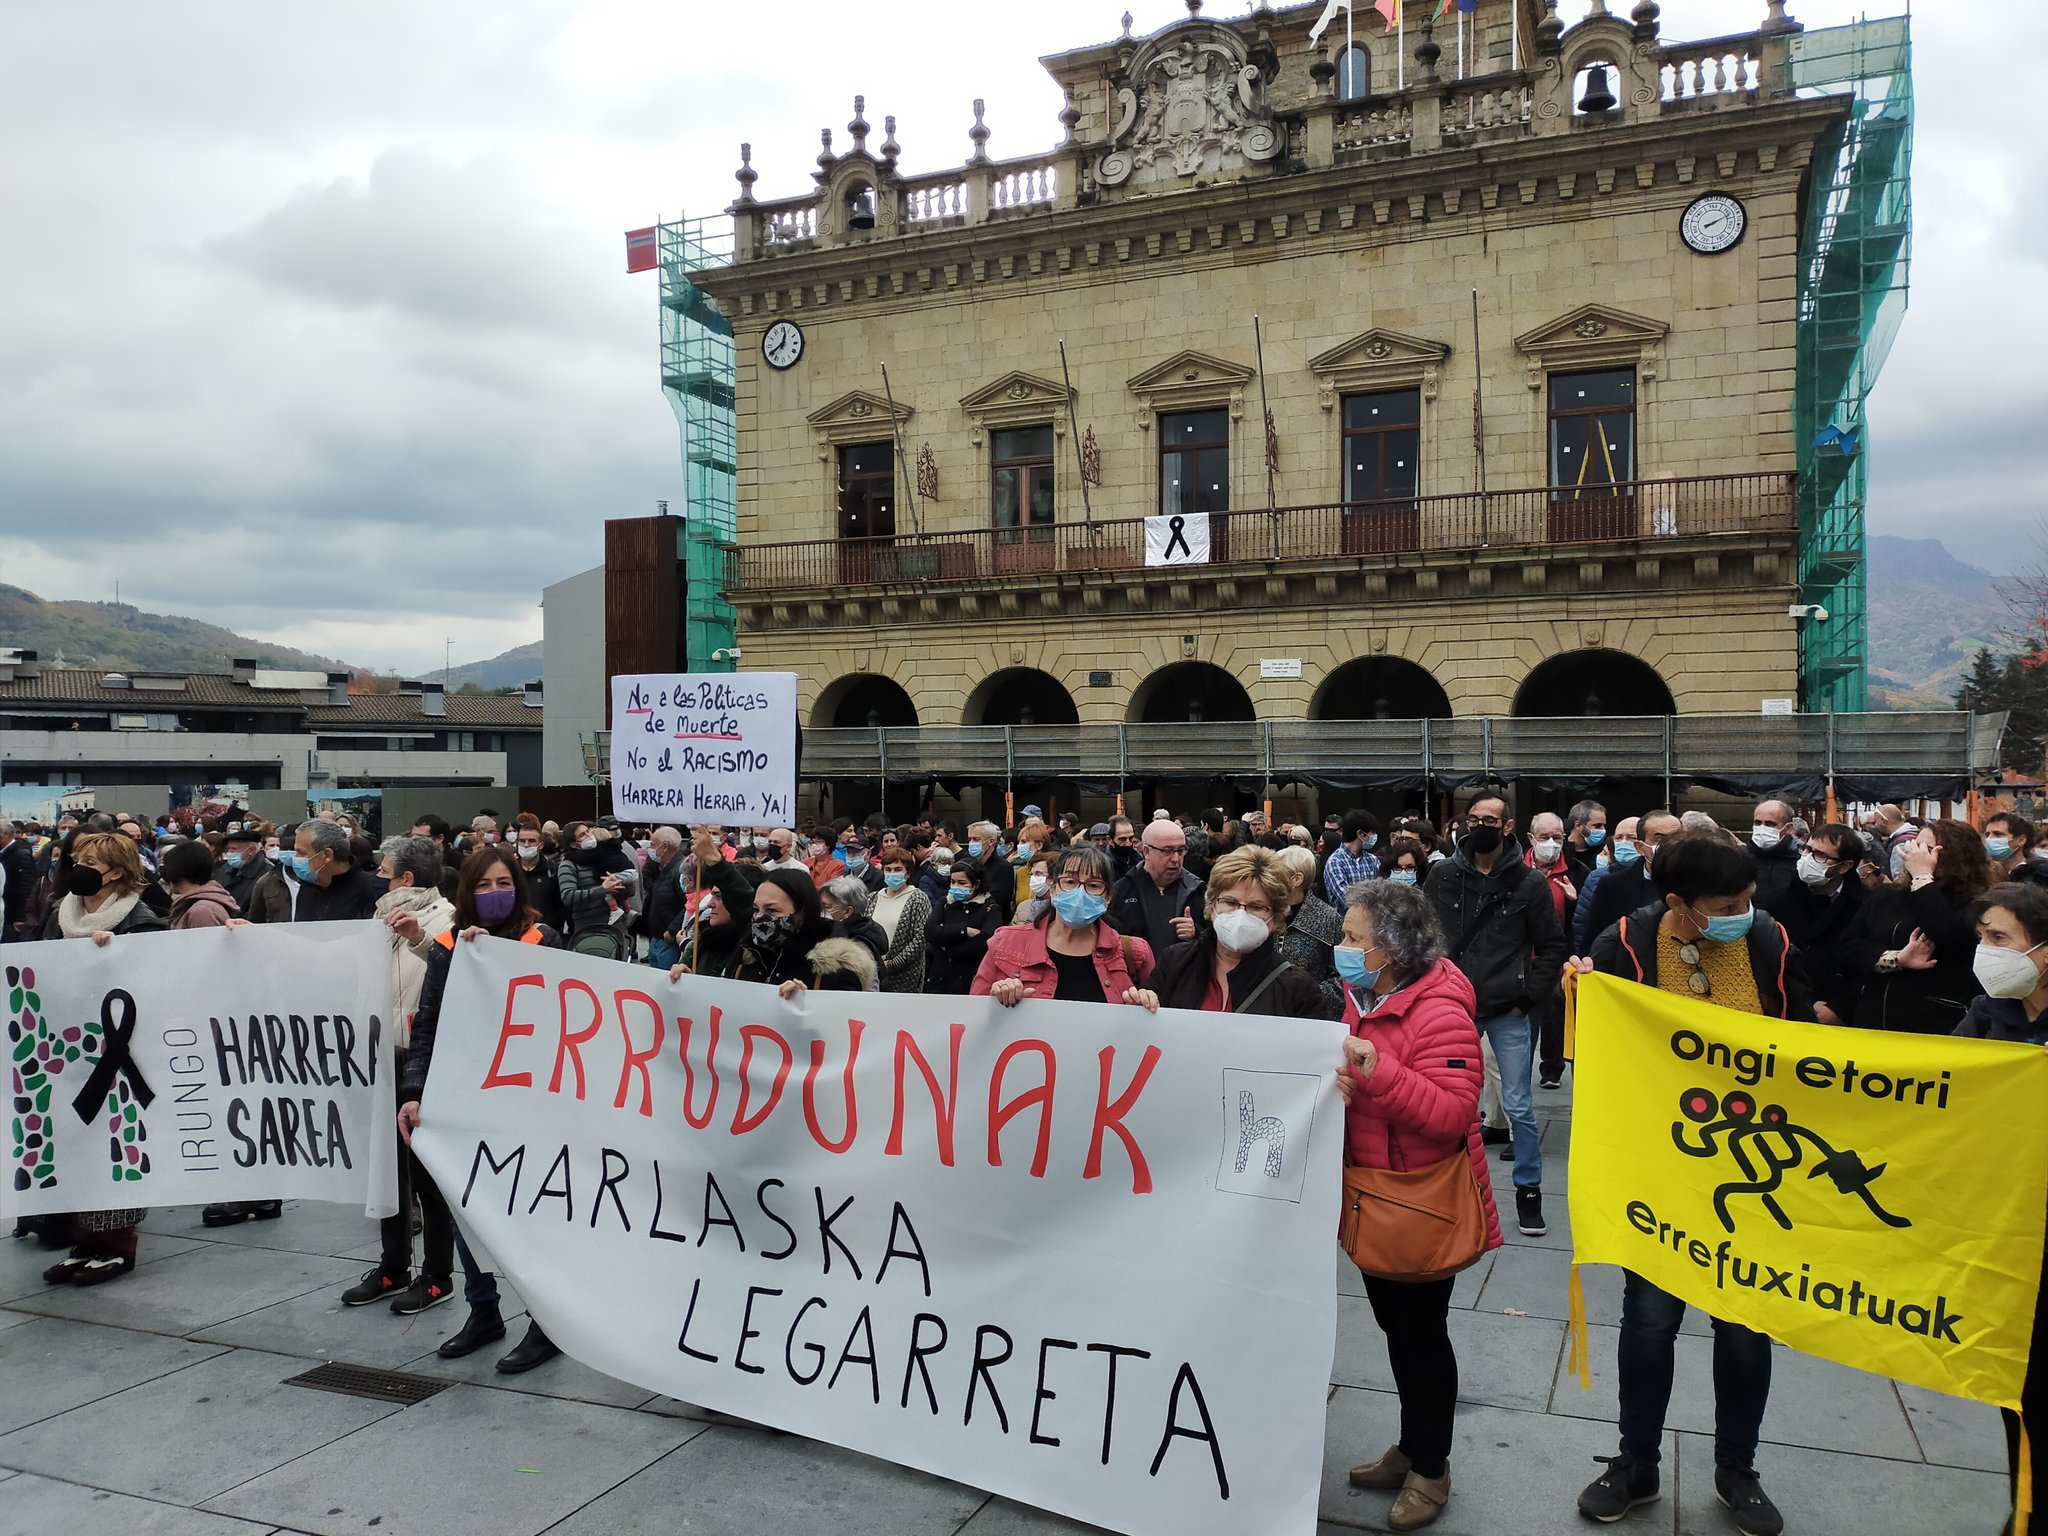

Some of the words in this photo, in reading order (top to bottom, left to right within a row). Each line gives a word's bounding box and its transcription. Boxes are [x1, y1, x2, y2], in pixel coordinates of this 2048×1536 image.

[645, 711, 666, 734] de
[673, 684, 696, 709] las
[697, 681, 768, 711] Politicas
[622, 782, 684, 808] HARRERA
[761, 792, 787, 823] YA!
[657, 747, 673, 773] al
[682, 746, 768, 773] RACISMO
[162, 1028, 220, 1172] IRUNGO
[226, 1097, 353, 1170] SAREA
[481, 973, 1162, 1194] ERRUDUNAK
[460, 1140, 932, 1296] MARLASKA
[1626, 1200, 1964, 1344] errefuxiatuak
[678, 1278, 1230, 1500] LEGARRETA
